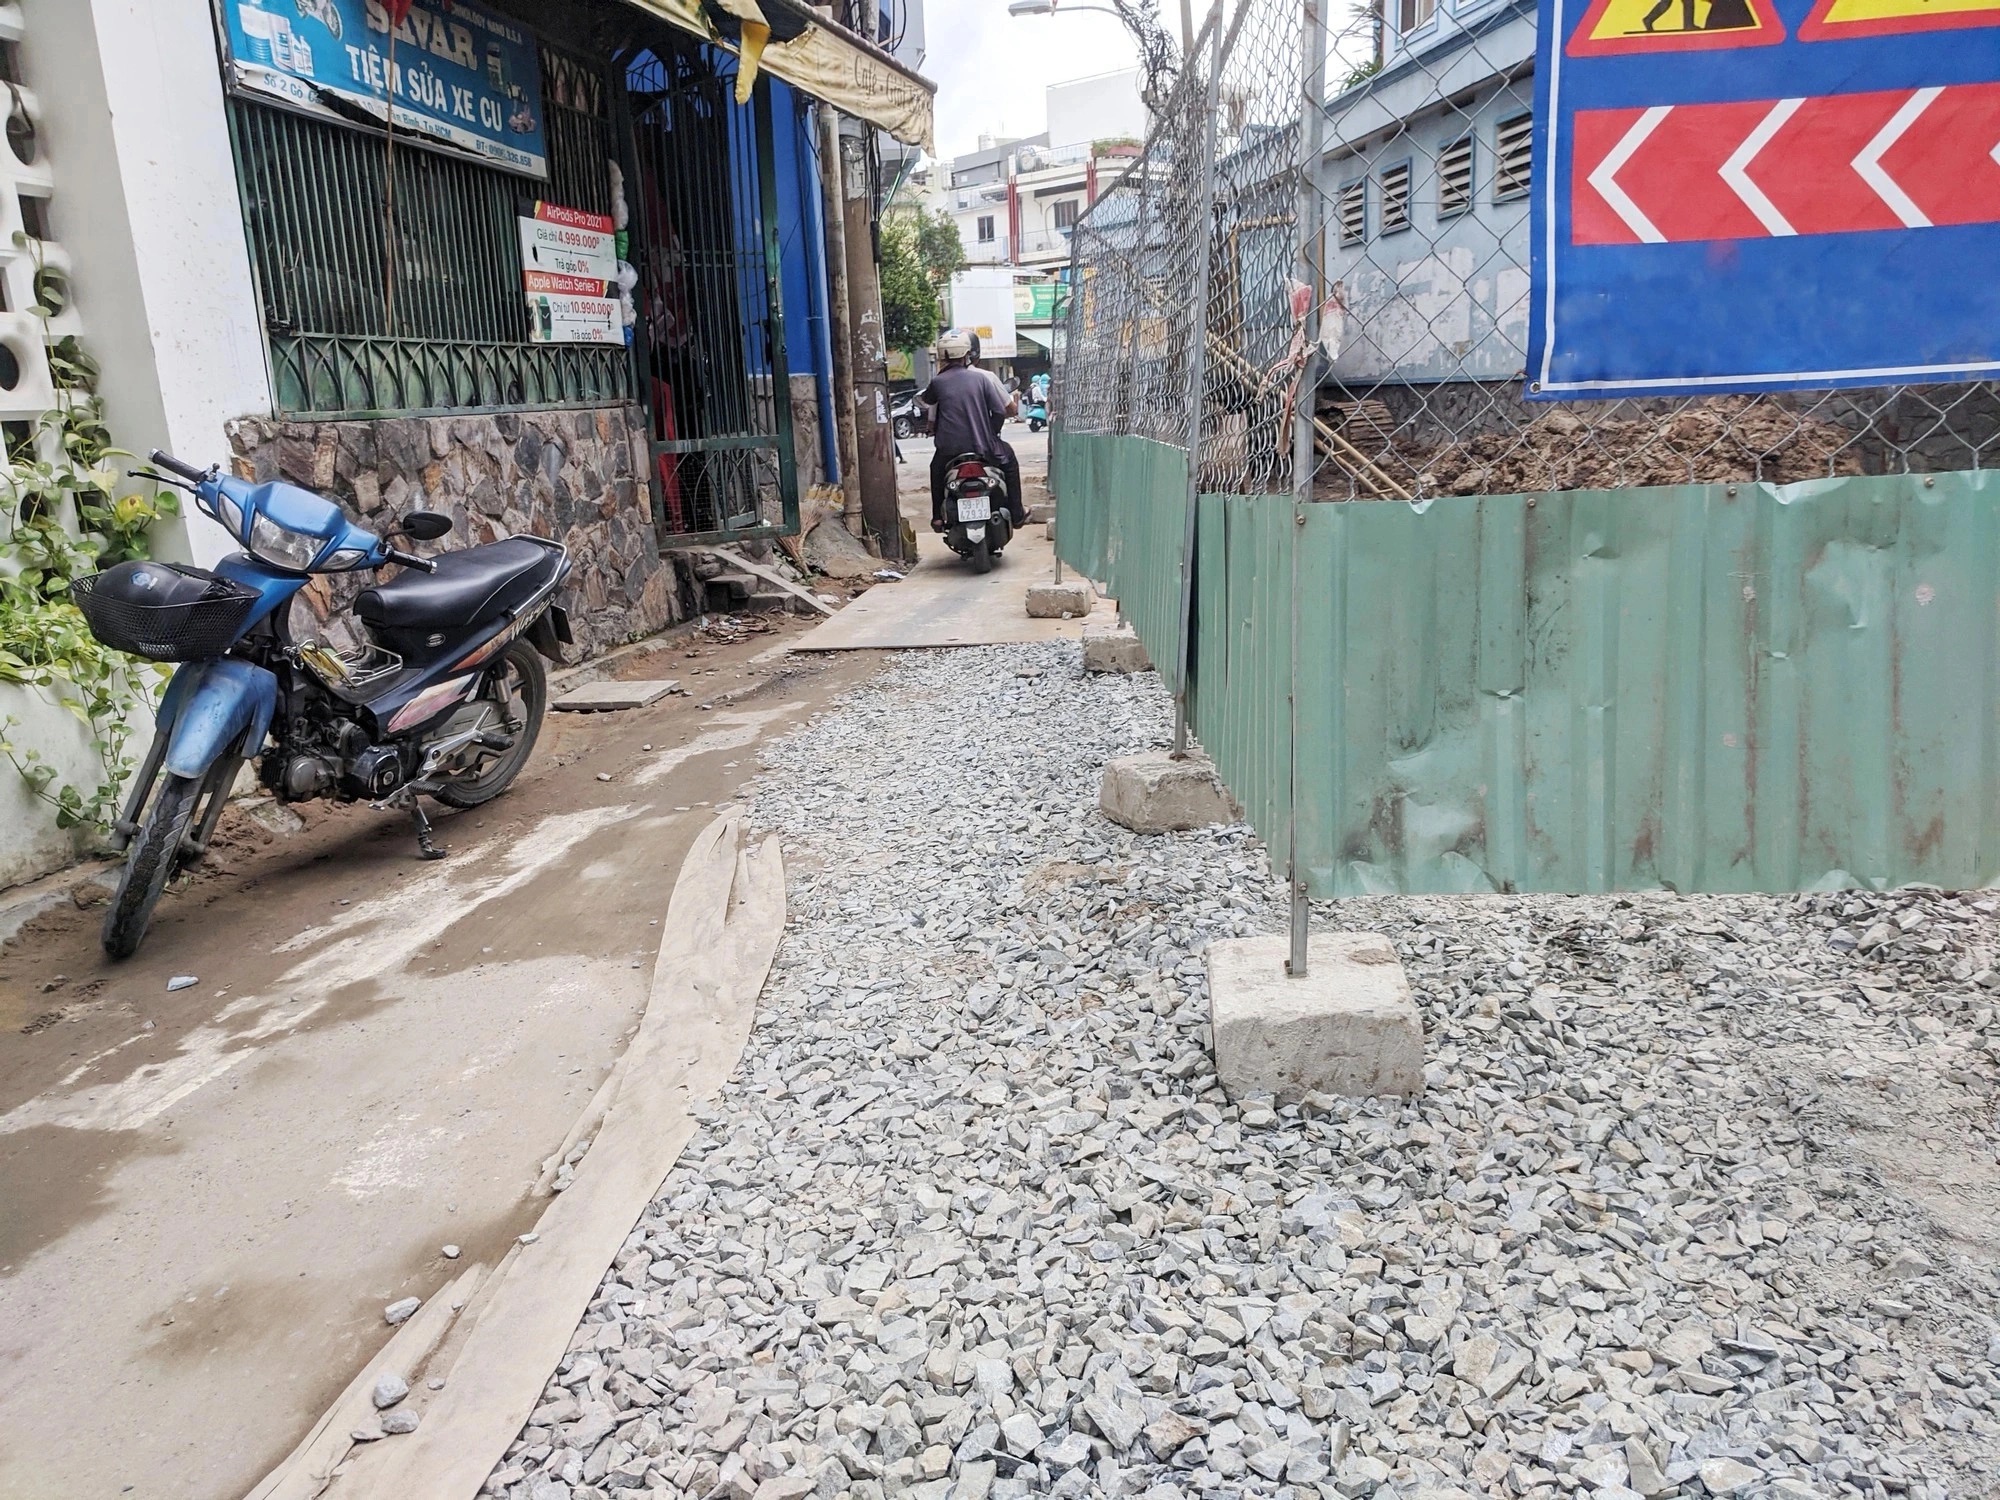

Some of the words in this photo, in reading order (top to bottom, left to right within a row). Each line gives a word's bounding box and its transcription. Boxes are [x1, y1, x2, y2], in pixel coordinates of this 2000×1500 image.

[264, 73, 277, 88] Số
[280, 79, 288, 92] 2
[290, 83, 304, 99] Gò
[345, 44, 403, 96] TIỆM
[408, 61, 448, 112] SỬA
[450, 84, 476, 122] XE
[480, 96, 502, 132] CU
[546, 205, 573, 222] AirPods
[574, 213, 585, 224] Pro
[587, 214, 603, 228] 2021
[537, 229, 548, 240] Giá
[555, 257, 565, 269] Trả
[566, 260, 577, 273] góp
[577, 259, 590, 273] 0%
[528, 275, 550, 291] Apple
[551, 278, 573, 290] Watch
[574, 279, 594, 292] Series
[595, 280, 600, 292] 7
[592, 329, 603, 340] 0%
